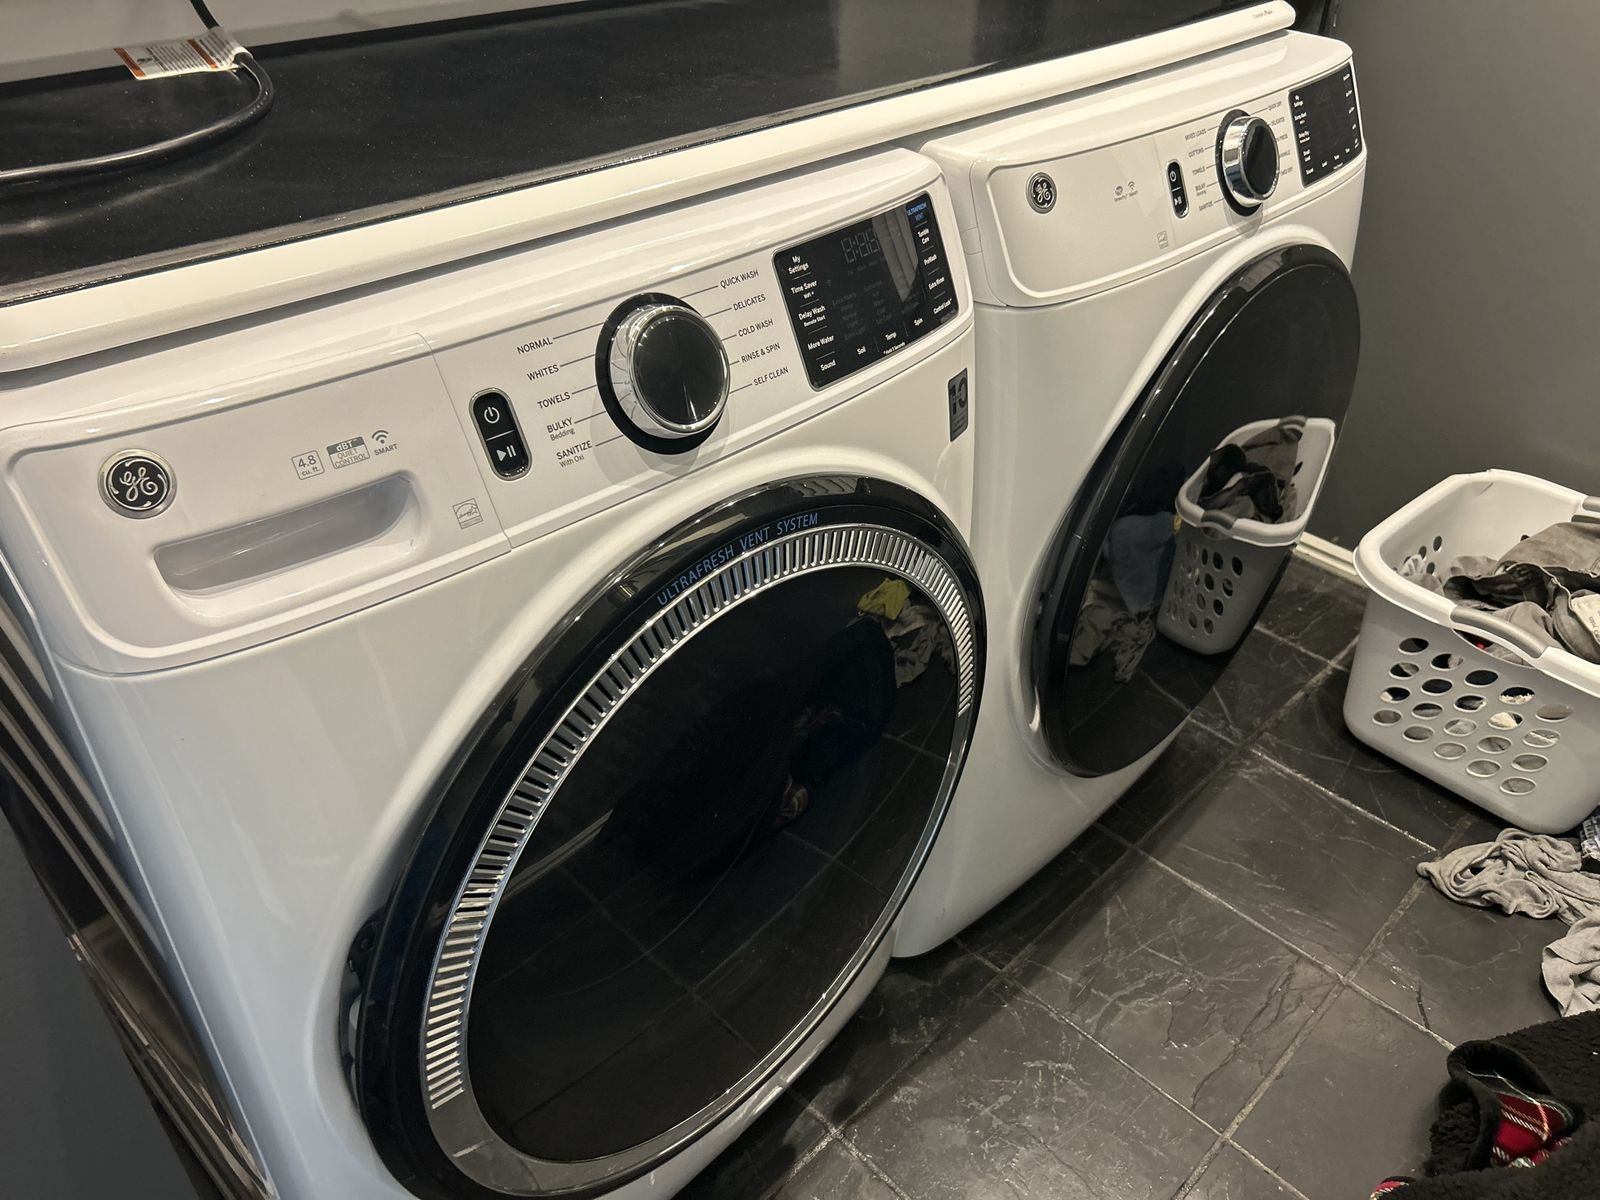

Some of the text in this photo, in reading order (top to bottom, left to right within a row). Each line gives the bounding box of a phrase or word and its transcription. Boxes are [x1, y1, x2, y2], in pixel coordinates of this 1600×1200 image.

[792, 255, 800, 263] My
[788, 262, 809, 274] Settings
[720, 270, 759, 289] QUICK WASH
[791, 280, 817, 294] Time Saver
[733, 294, 766, 311] DELICATES
[798, 305, 826, 321] Delay Wash
[738, 319, 774, 338] COLD WASH
[808, 335, 834, 350] More Water
[885, 332, 896, 341] Temp
[517, 336, 553, 355] NORMAL
[741, 342, 780, 364] RINSE & SPIN
[857, 346, 866, 354] Soil
[527, 364, 559, 381] WHITES
[820, 360, 836, 371] Sound
[753, 366, 789, 386] SELF CLEAN
[537, 392, 571, 410] TOWELS
[547, 418, 573, 434] BULKY
[550, 428, 575, 442] Bedding
[337, 448, 358, 460] QUIET
[374, 443, 398, 456] SMART
[556, 440, 592, 460] SANITIZE
[298, 455, 317, 468] 4.8
[334, 453, 367, 468] CONTROL
[559, 454, 585, 468] With Oxi
[312, 466, 320, 474] ft.
[656, 512, 818, 606] ULTRAFRESH VENT SYSTEM
